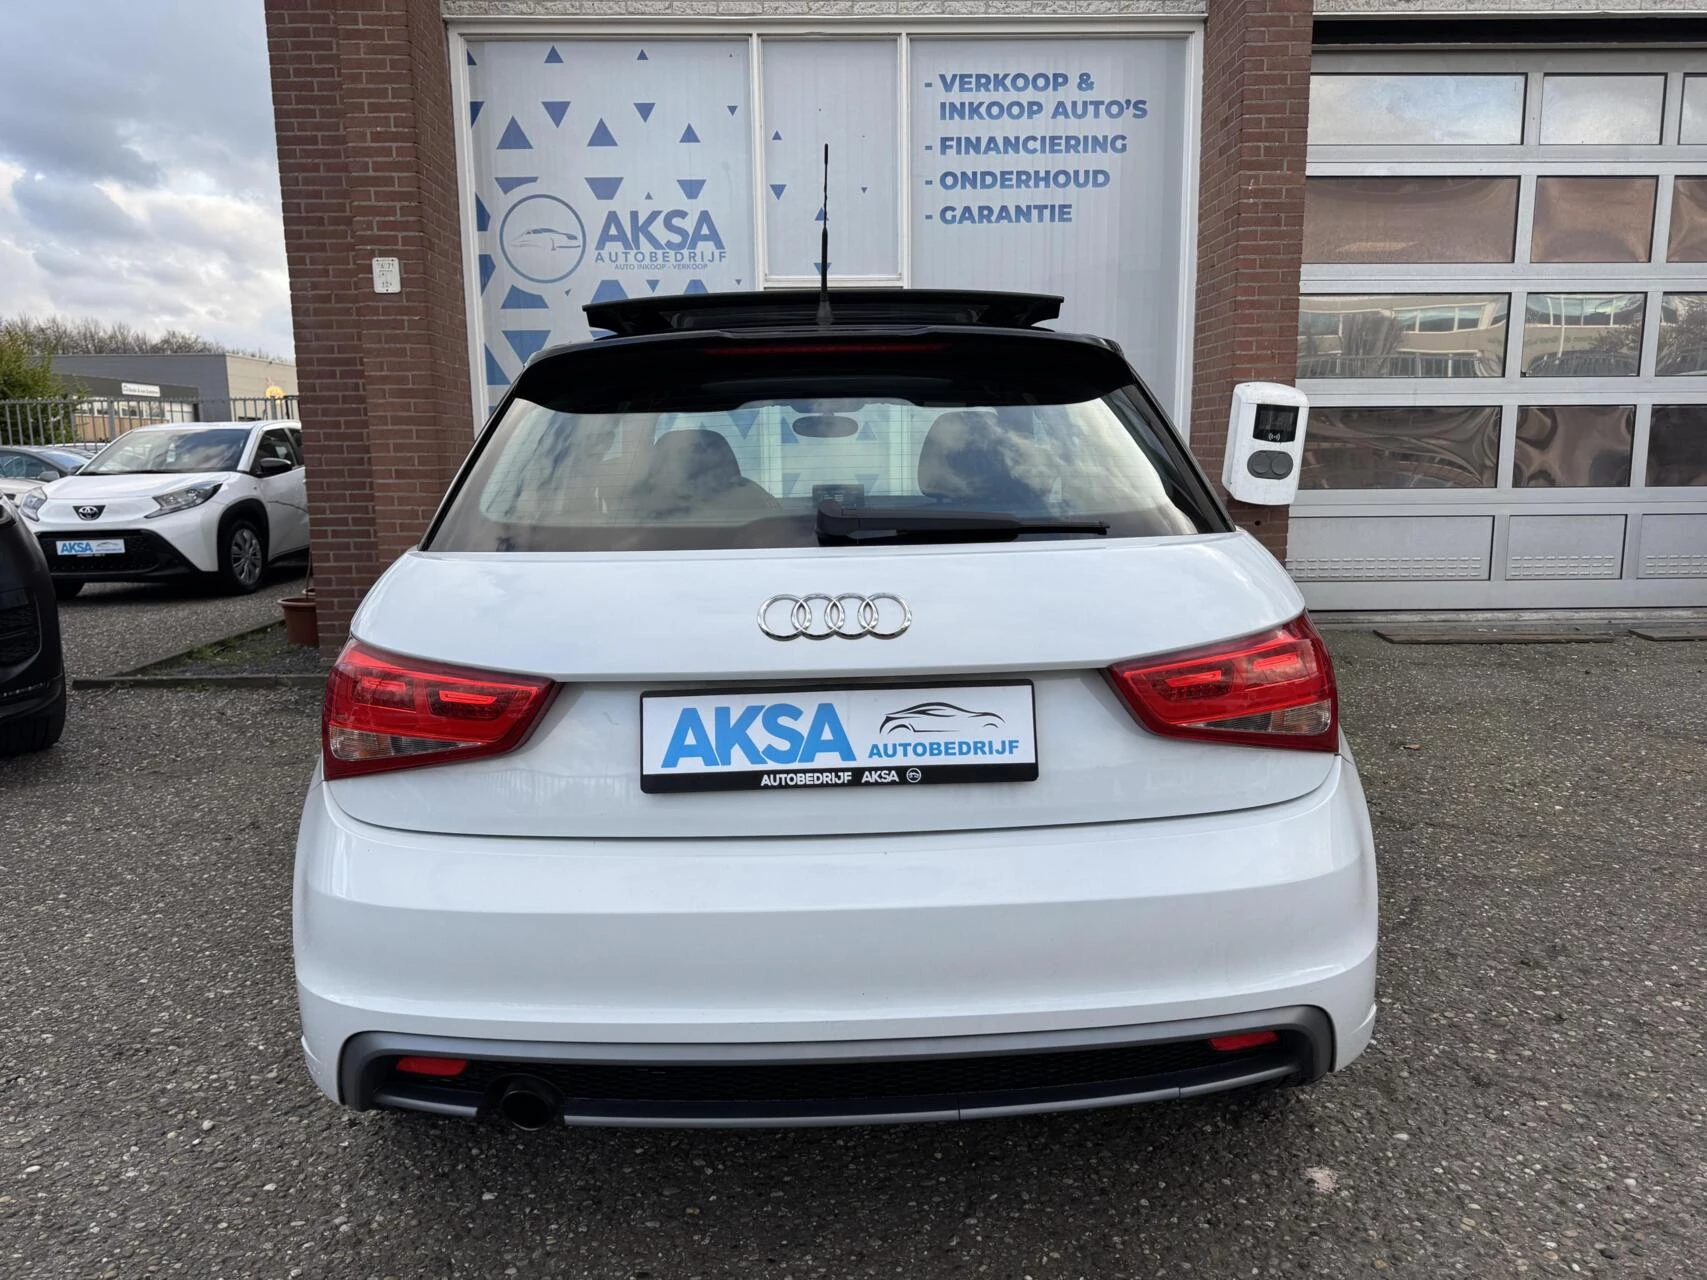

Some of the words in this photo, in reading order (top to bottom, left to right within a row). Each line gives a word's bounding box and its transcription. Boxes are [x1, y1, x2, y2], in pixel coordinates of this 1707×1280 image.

[939, 73, 1069, 93] VERKOOP
[1076, 72, 1095, 92] &
[939, 101, 1044, 121] INKOOP
[1051, 99, 1149, 120] AUTO'S
[939, 134, 1128, 155] FINANCIERING
[939, 169, 1111, 191] ONDERHOUD
[939, 204, 1073, 225] GARANTIE
[594, 209, 726, 251] AKSA
[594, 251, 727, 263] AUTOBEDRIJF
[614, 263, 635, 271] AUTO
[637, 263, 667, 271] INKOOP
[672, 263, 708, 271] VERKOOP
[60, 541, 94, 554] AKSA
[660, 703, 858, 769] AKSA
[868, 740, 1020, 759] AUTOBEDRIJF
[760, 772, 853, 787] AUTOBEDRIJF
[861, 770, 900, 784] AKSA
